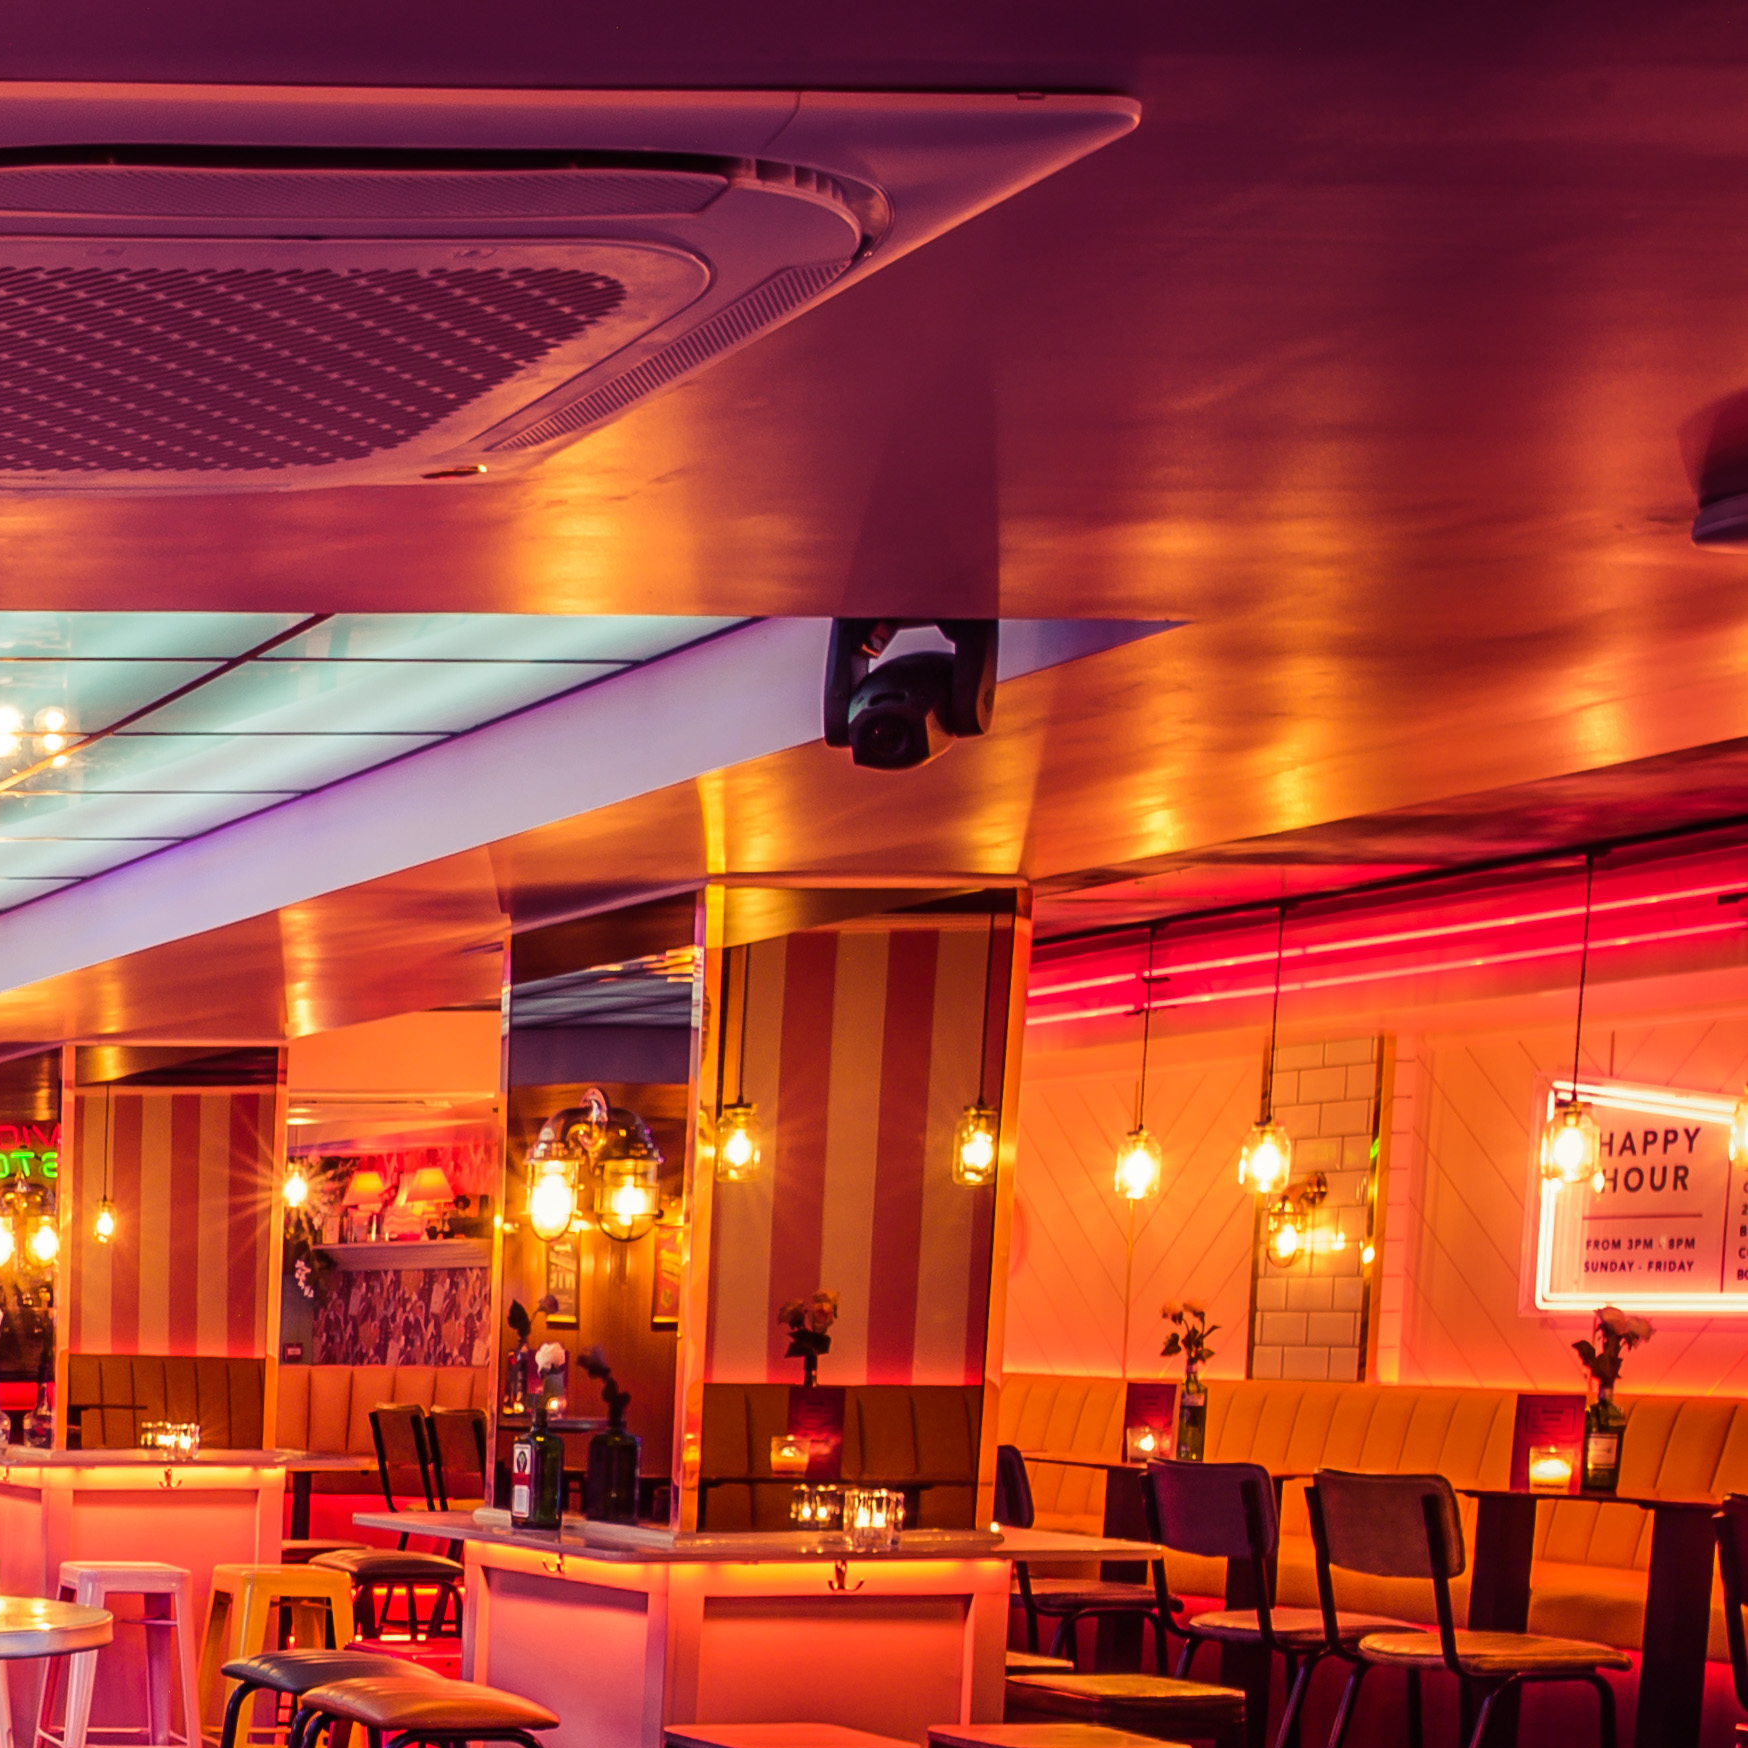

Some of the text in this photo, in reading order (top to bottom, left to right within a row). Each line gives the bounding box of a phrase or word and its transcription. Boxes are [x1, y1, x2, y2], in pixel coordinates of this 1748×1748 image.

[1598, 1127, 1701, 1158] HAPPY
[1601, 1165, 1690, 1194] HOUR
[1585, 1238, 1622, 1251] FROM
[1627, 1238, 1653, 1251] 3PM
[1668, 1237, 1696, 1250] 8PM
[1583, 1260, 1635, 1273] SUNDAY
[1647, 1260, 1695, 1273] FRIDAY
